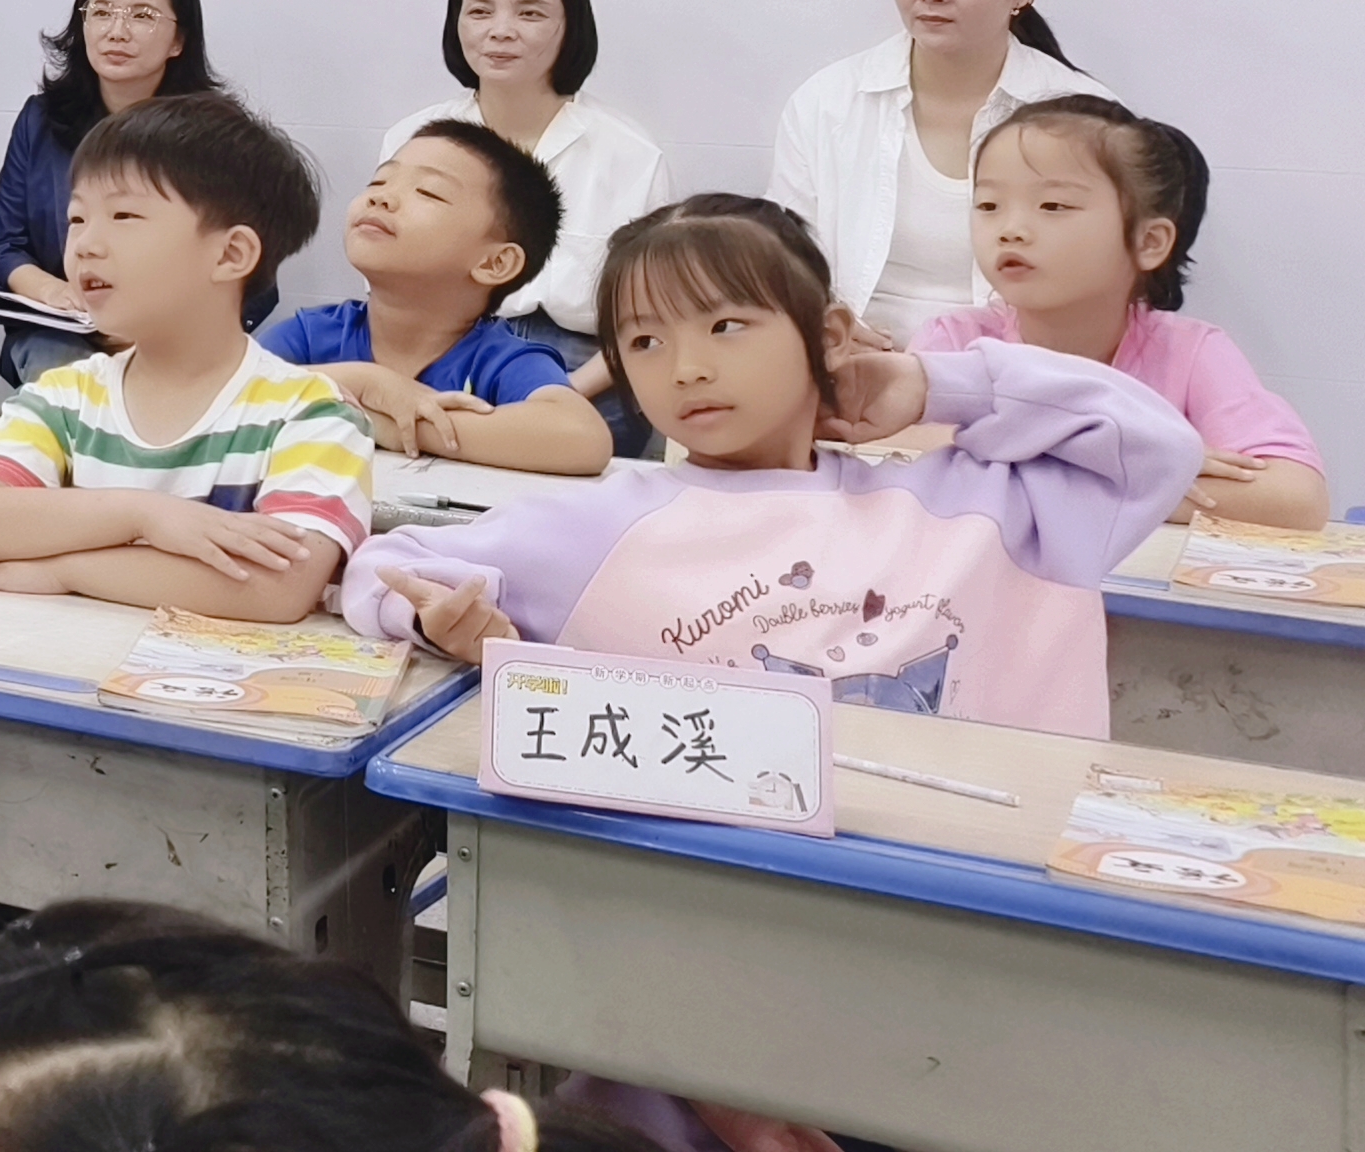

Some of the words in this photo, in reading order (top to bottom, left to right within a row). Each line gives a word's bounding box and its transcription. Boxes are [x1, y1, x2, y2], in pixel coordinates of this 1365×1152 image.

[661, 573, 769, 654] Kuromi
[752, 603, 808, 634] Double
[520, 703, 735, 783] 王成溪
